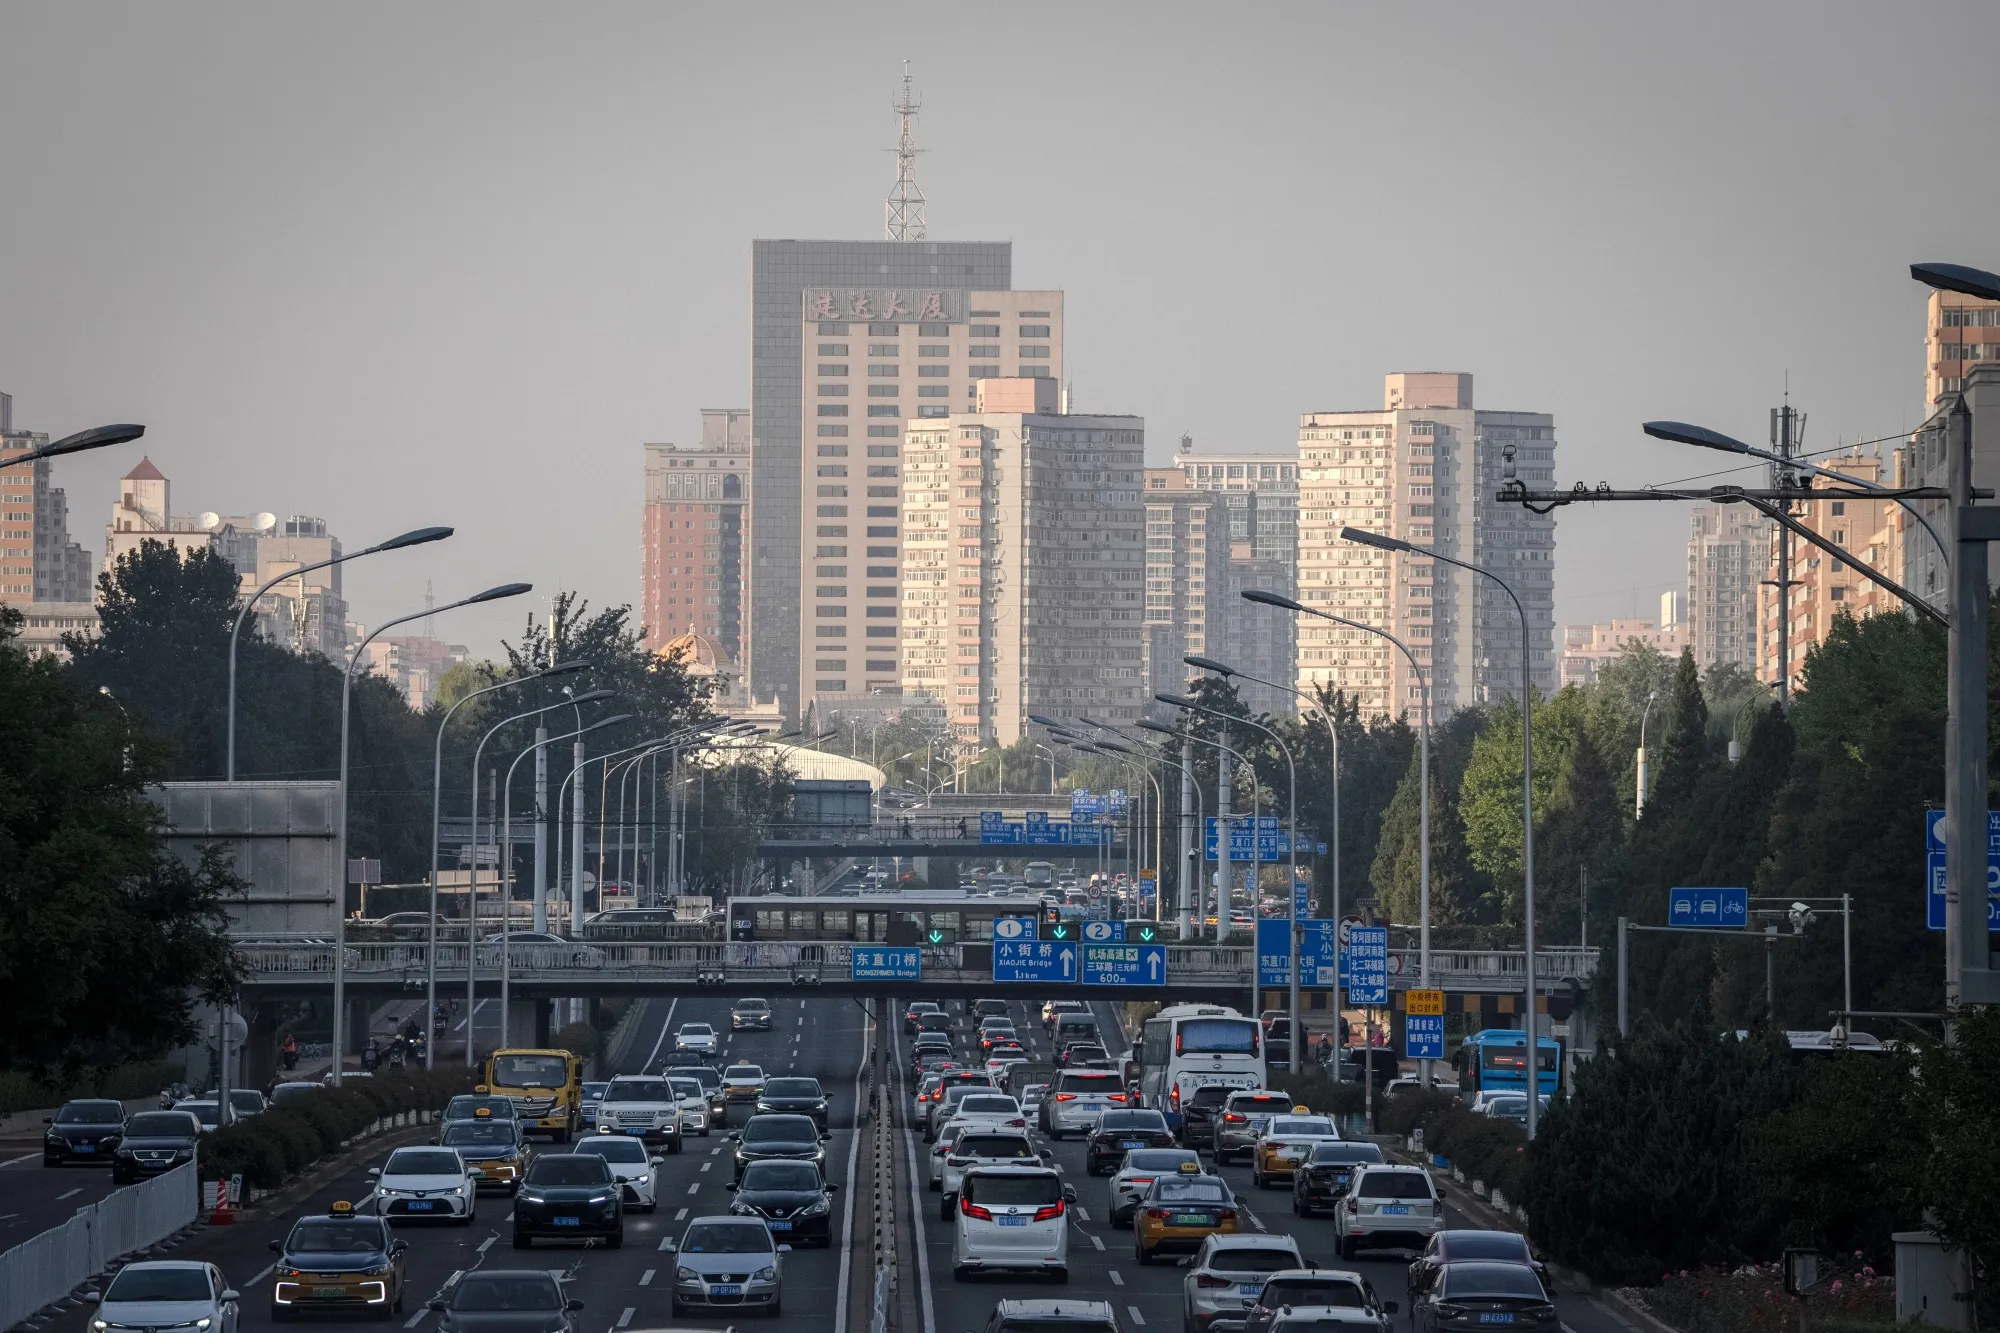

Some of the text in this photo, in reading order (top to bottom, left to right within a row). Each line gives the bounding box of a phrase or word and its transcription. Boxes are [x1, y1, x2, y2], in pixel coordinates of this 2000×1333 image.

[1006, 923, 1012, 935] 1
[1024, 920, 1032, 938] 出口
[1094, 924, 1104, 938] 2
[1114, 923, 1122, 940] 出口
[1351, 931, 1385, 944] 香河园西街
[1000, 943, 1052, 957] 小街桥
[1088, 948, 1125, 961] 机场高速
[1351, 945, 1385, 957] 西坝河南路
[856, 952, 917, 967] 东直门桥
[1028, 959, 1052, 968] Bridge
[1351, 959, 1385, 972] 北二环辅路
[856, 969, 917, 978] DONGZHIMEN Bridge
[1351, 973, 1385, 986] 东土城路
[1351, 988, 1372, 1002] 650m
[1409, 992, 1440, 1002] 小街桥东
[1409, 1003, 1439, 1013] 出口封闭
[1408, 1018, 1442, 1031] 请提前进入
[1409, 1033, 1440, 1043] 辅路行驶
